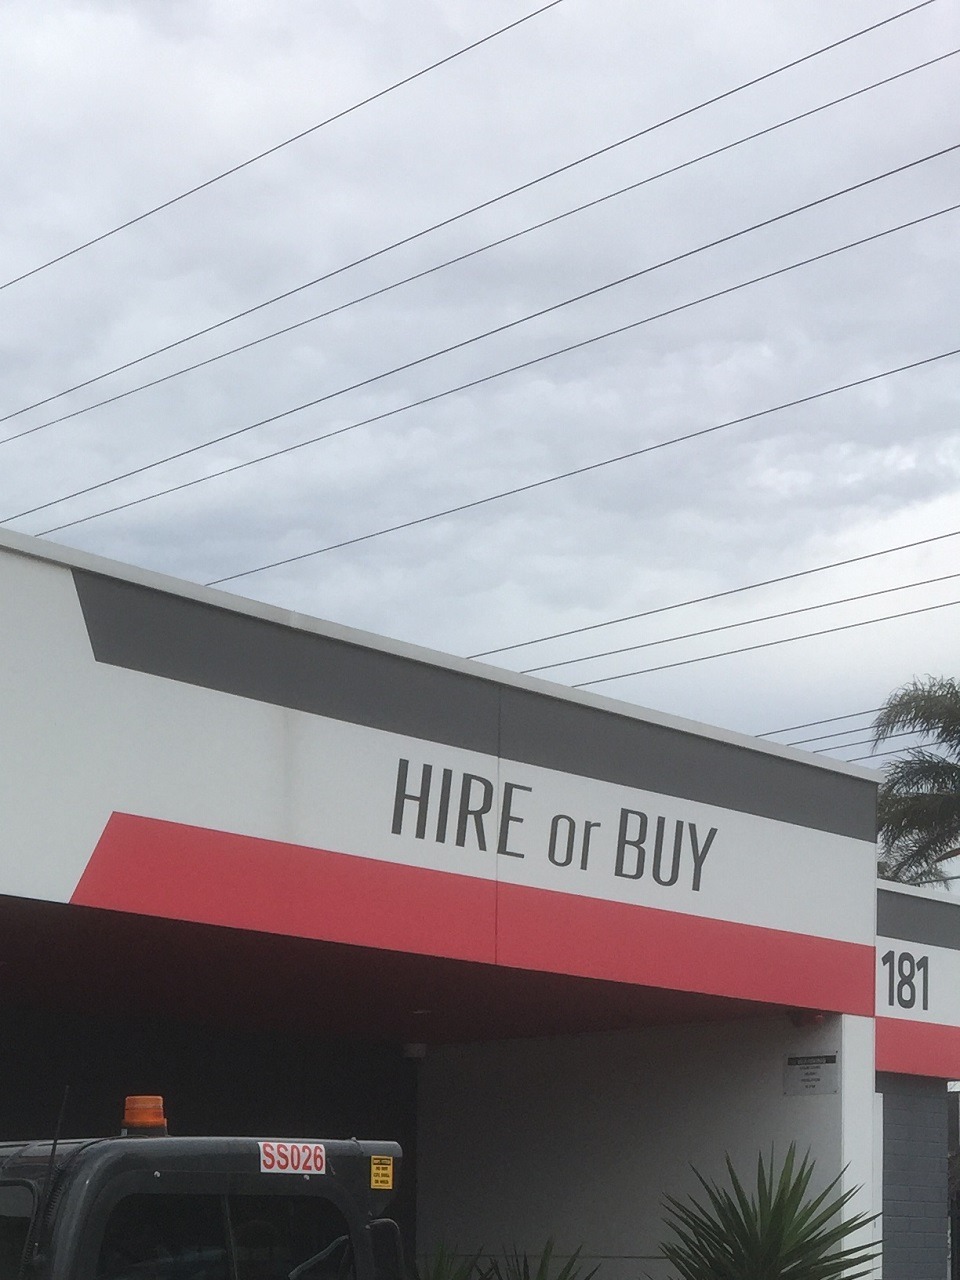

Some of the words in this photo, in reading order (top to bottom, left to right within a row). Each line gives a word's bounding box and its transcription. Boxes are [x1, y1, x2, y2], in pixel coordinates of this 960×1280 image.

[391, 757, 533, 859] HIRE
[547, 814, 602, 871] or
[614, 807, 719, 892] BUY
[881, 949, 929, 1011] 181
[262, 1143, 324, 1171] SS026
